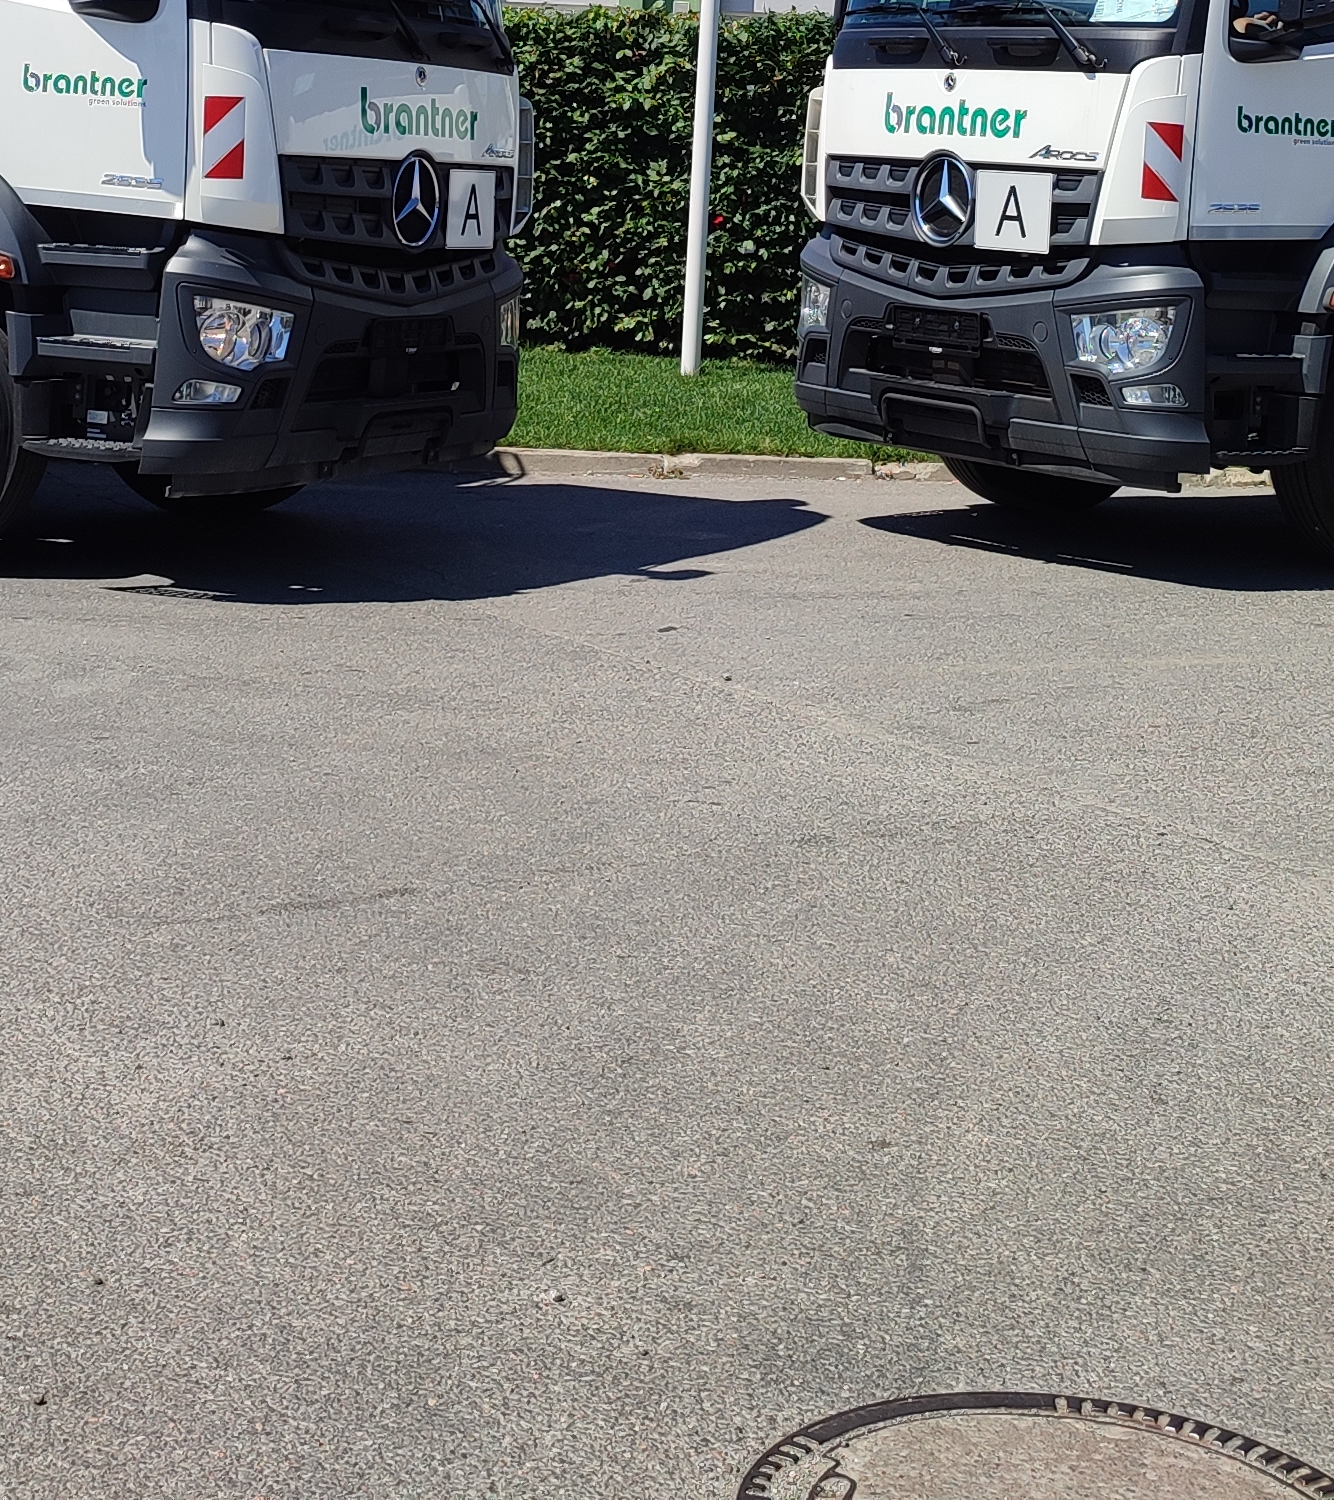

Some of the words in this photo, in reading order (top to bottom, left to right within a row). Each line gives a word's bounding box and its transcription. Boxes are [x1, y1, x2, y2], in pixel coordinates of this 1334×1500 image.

[22, 63, 149, 99] brantner
[88, 99, 110, 107] green
[360, 86, 479, 141] brantner
[884, 91, 1029, 139] brantner
[1292, 138, 1311, 146] green
[460, 183, 482, 237] A
[994, 184, 1027, 239] A
